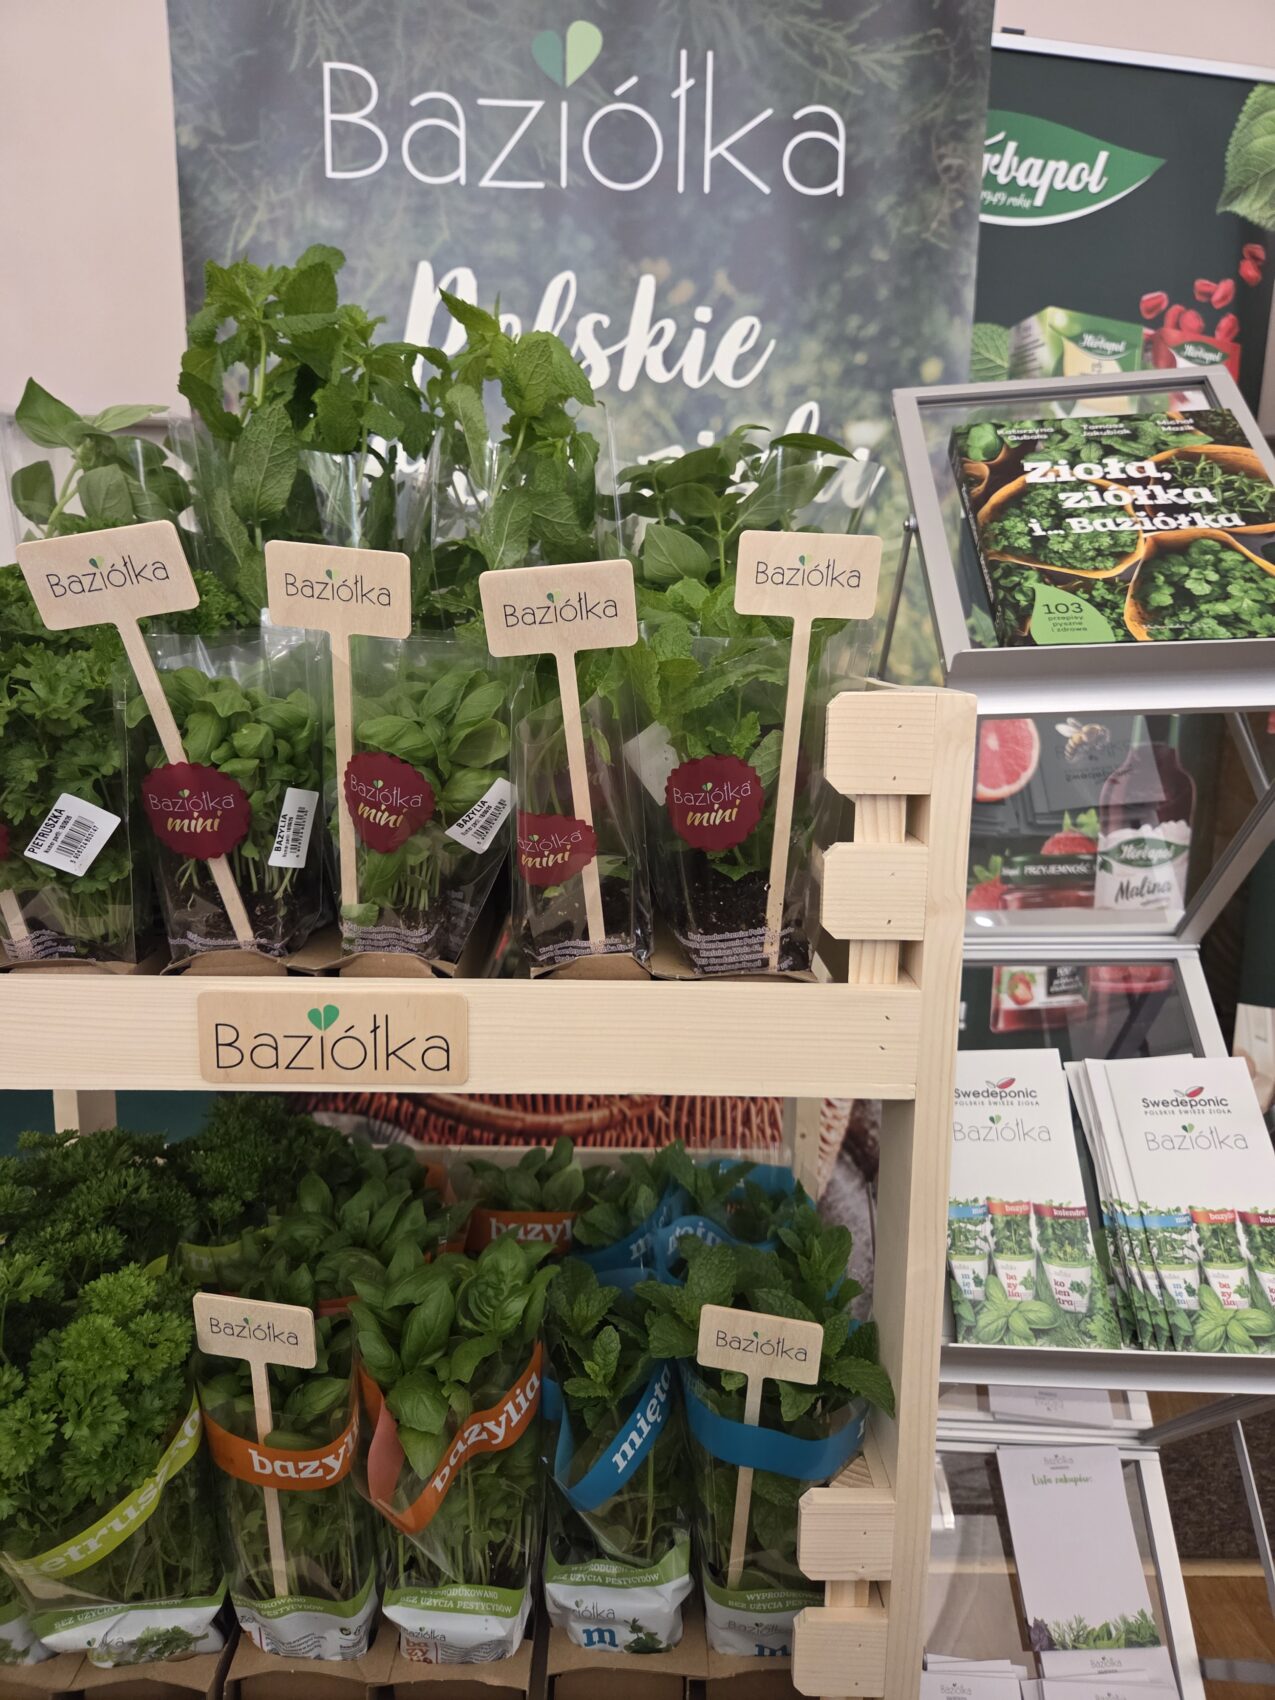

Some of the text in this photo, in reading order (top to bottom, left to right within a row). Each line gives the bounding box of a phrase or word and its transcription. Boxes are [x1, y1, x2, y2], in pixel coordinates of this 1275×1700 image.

[323, 48, 845, 196] Baziółka
[1022, 458, 1172, 484] Zioła,
[1058, 485, 1218, 509] ziółka
[1066, 511, 1246, 535] Baziółka
[45, 554, 170, 598] Baziółka
[755, 559, 861, 589] Baziółka
[284, 570, 392, 608] Baziółka
[503, 591, 618, 628] Baziółka
[1042, 602, 1083, 614] 103
[148, 791, 235, 812] Baziółka
[350, 774, 423, 808] Baziółka
[673, 780, 751, 805] Baziółka
[167, 810, 222, 834] mini
[358, 802, 408, 828] mini
[456, 800, 488, 829] BAZYLIA
[686, 799, 741, 827] mini
[28, 808, 66, 855] PIETRUSZKA
[274, 813, 288, 852] BAZYLIA
[521, 844, 571, 869] mini
[1114, 876, 1172, 903] Malina
[215, 1014, 451, 1072] Baziółka
[954, 1087, 1038, 1100] Swedeponic
[1142, 1096, 1229, 1109] Swedeponic
[953, 1117, 1051, 1142] Baziółka
[1144, 1125, 1249, 1151] Baziółka
[209, 1316, 300, 1347] Baziółka
[715, 1330, 808, 1363] Baziółka
[431, 1371, 541, 1493] bazylia
[612, 1366, 671, 1474] mięta
[605, 1573, 659, 1585] PESTYCYDÓW
[421, 1596, 454, 1609] UŻYCIA
[457, 1600, 512, 1613] PESTYCYDÓW
[582, 1627, 618, 1648] m
